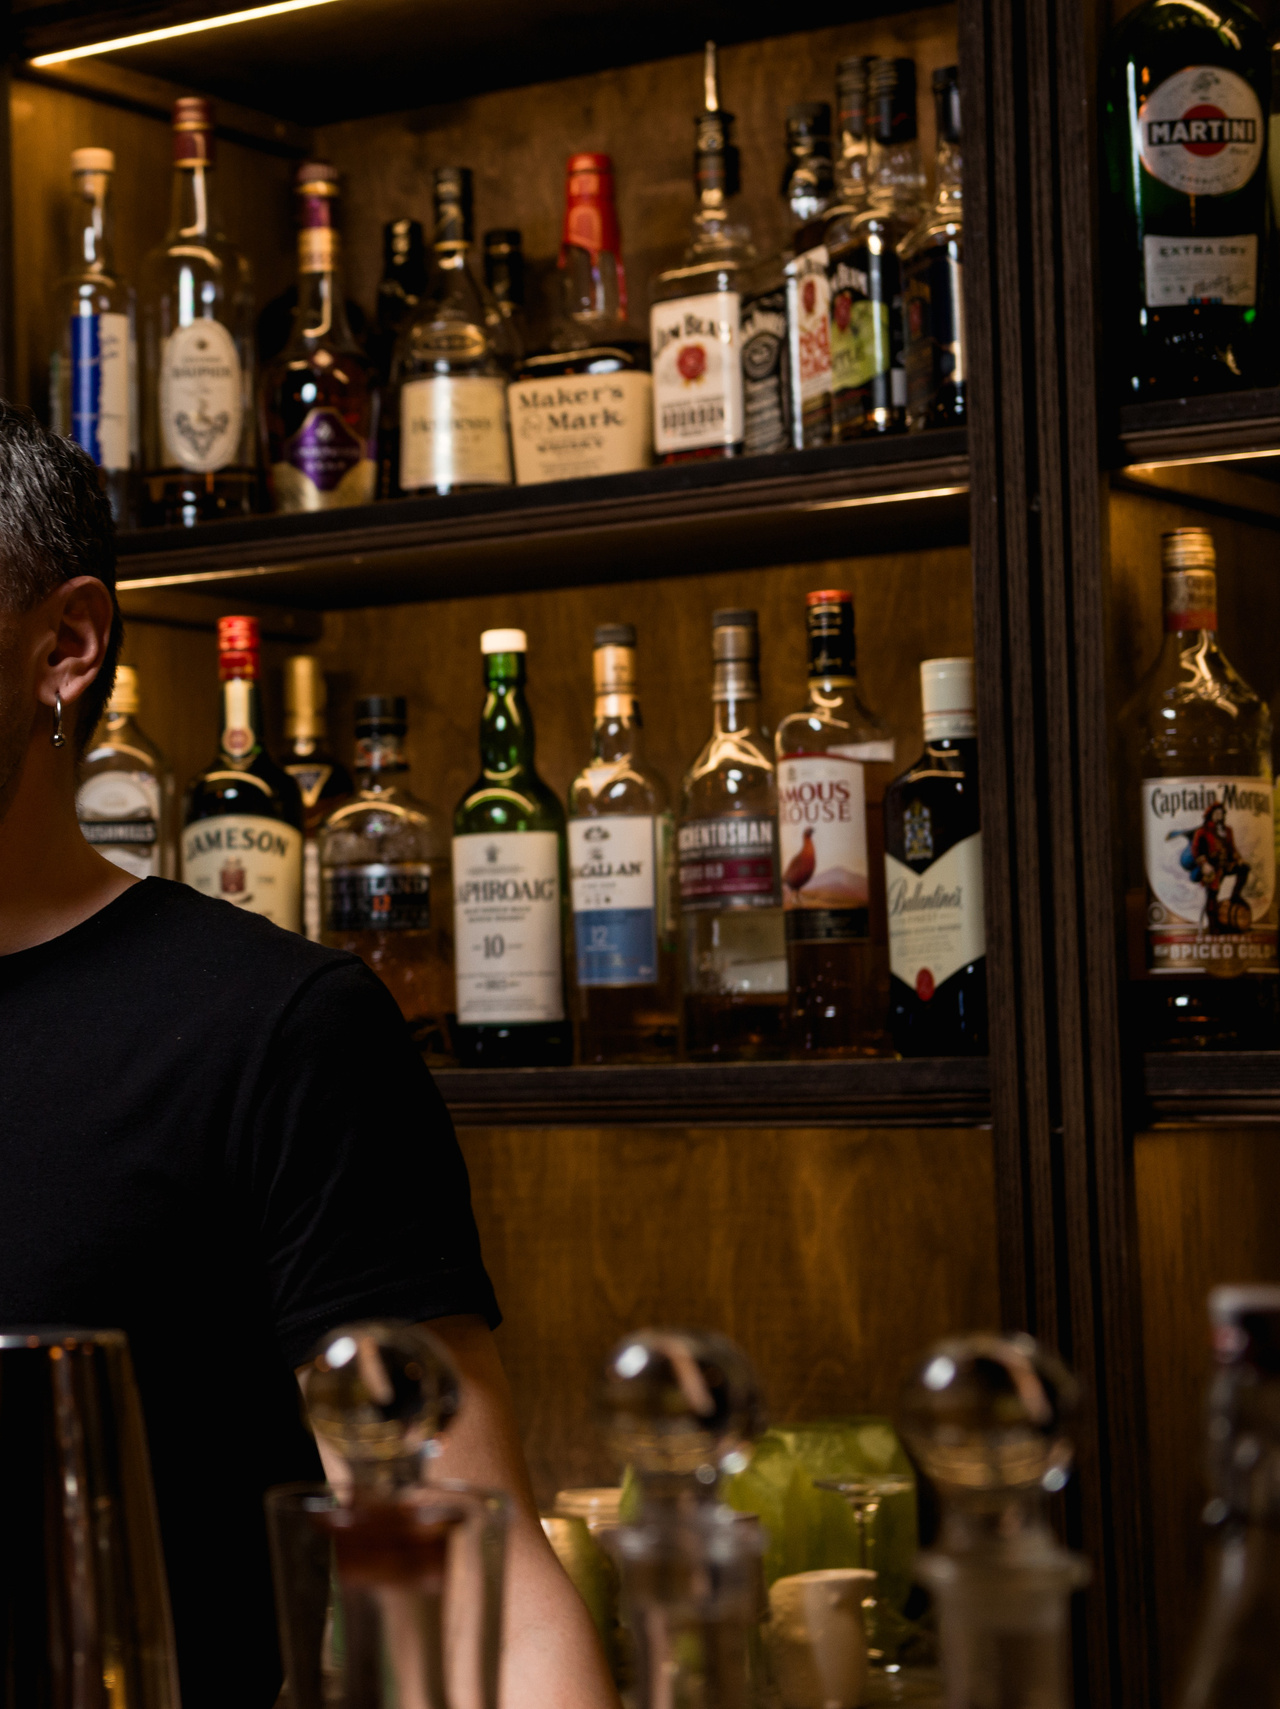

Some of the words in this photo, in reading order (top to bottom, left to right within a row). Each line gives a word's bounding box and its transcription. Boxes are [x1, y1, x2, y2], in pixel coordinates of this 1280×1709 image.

[1151, 120, 1254, 143] MARTINI
[1159, 245, 1214, 257] EXTRA
[1219, 245, 1246, 256] DRY
[653, 325, 681, 358] JIM
[519, 383, 625, 408] Maker's
[548, 406, 625, 431] Mark
[662, 404, 726, 430] BOURBON
[1151, 783, 1218, 818] Captain
[1220, 782, 1271, 817] Morga
[186, 826, 290, 860] JAMESON
[889, 877, 963, 917] Ballantine's
[482, 933, 505, 959] 10
[1169, 943, 1234, 960] SPICED
